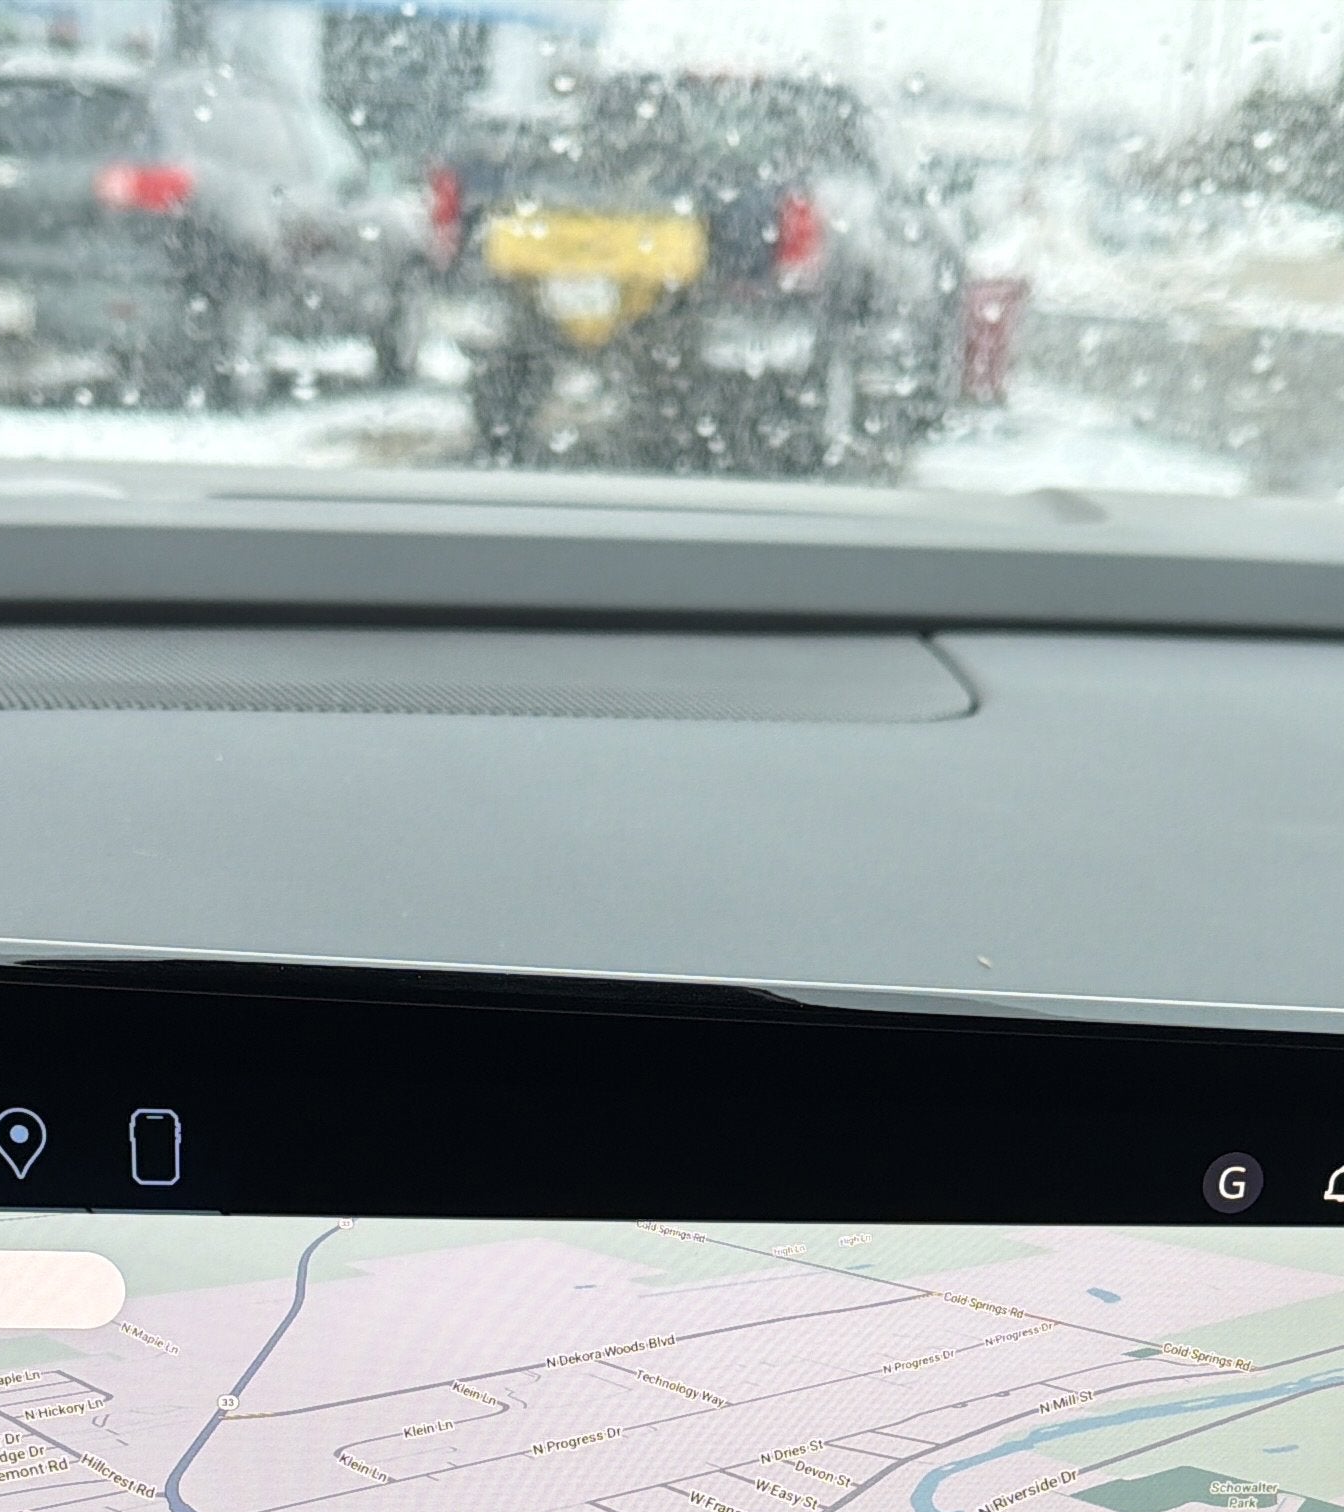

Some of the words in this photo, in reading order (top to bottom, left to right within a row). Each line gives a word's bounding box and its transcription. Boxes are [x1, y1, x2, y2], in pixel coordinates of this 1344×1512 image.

[1219, 1167, 1245, 1199] G
[944, 1292, 967, 1306] Cold
[970, 1298, 1007, 1316] Springs
[1010, 1307, 1024, 1319] Rd
[546, 1357, 556, 1368] N
[560, 1350, 601, 1366] Dekora
[605, 1341, 645, 1357] Woods
[649, 1334, 675, 1349] Blvd
[1163, 1343, 1188, 1358] Cold
[1191, 1348, 1233, 1369] Springs
[1235, 1359, 1250, 1372] Rd
[25, 1371, 40, 1381] Ln
[636, 1369, 698, 1399] Technology
[701, 1390, 724, 1407] Way
[25, 1410, 35, 1420] N
[39, 1403, 84, 1418] Hickory
[88, 1400, 103, 1411] Ln
[1040, 1404, 1050, 1415] N
[1053, 1395, 1077, 1412] Mill
[1079, 1391, 1093, 1403] St
[5, 1432, 21, 1445] Dr
[404, 1424, 435, 1439] Klein
[438, 1420, 453, 1431] Ln
[533, 1444, 544, 1455] N
[547, 1432, 604, 1454] Progress
[606, 1426, 622, 1438] Dr
[27, 1445, 45, 1458] Dr
[761, 1453, 771, 1465] N
[774, 1445, 806, 1462] Dries
[808, 1439, 824, 1452] St
[48, 1458, 68, 1472] Rd
[81, 1453, 135, 1494] Hillcrest
[135, 1481, 156, 1499] Rd
[339, 1454, 370, 1477] Klein
[371, 1470, 387, 1482] Ln
[795, 1461, 831, 1482] Devon
[835, 1473, 851, 1488] St
[690, 1490, 705, 1505] W
[756, 1478, 772, 1493] W
[771, 1483, 801, 1509] Easy
[803, 1496, 819, 1511] St
[993, 1478, 1057, 1512] Riverside
[1060, 1470, 1078, 1485] Dr
[1210, 1481, 1278, 1495] Schowalter
[1228, 1498, 1257, 1509] Park
